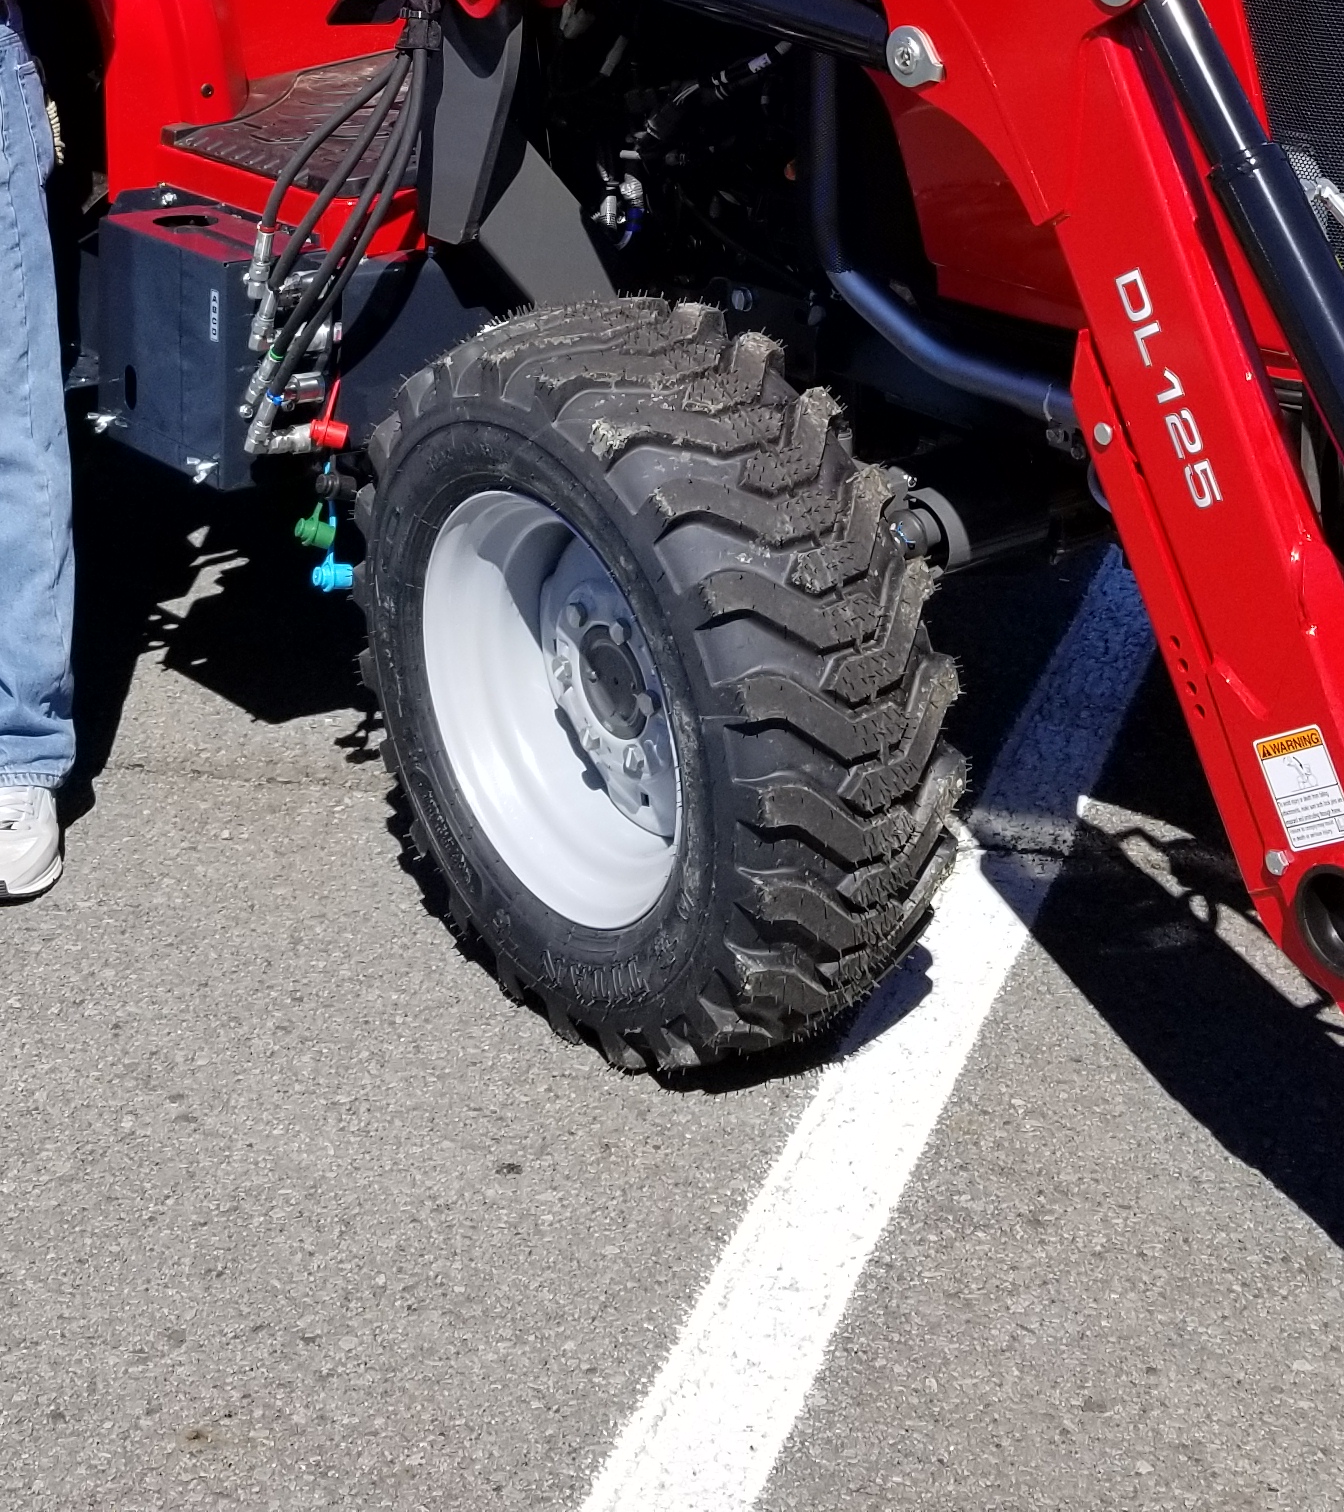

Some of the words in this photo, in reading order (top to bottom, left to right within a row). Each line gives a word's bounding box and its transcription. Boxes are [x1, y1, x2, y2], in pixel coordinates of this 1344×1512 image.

[1115, 267, 1162, 368] DL
[1156, 366, 1223, 509] 125
[1268, 732, 1320, 756] WARNING
